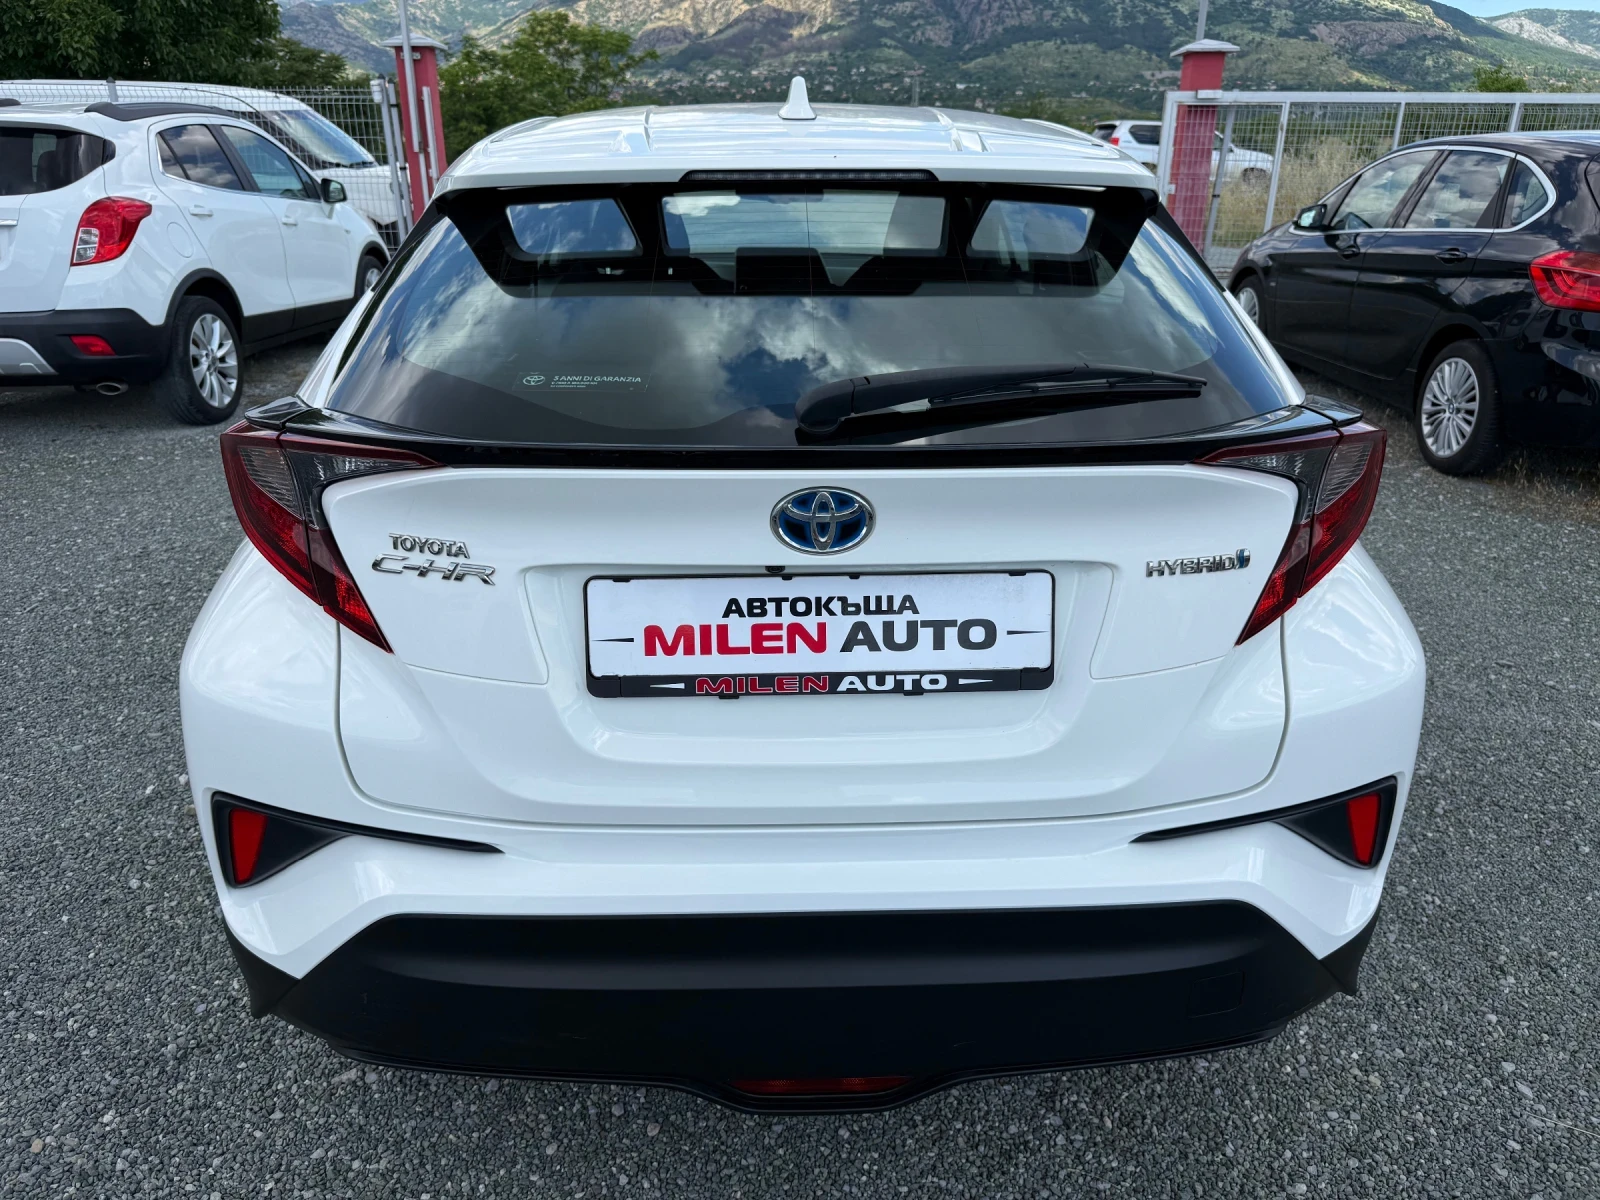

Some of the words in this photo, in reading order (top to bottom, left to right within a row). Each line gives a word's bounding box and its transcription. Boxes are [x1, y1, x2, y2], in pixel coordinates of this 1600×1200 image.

[594, 375, 642, 383] GARANZIA
[389, 533, 470, 559] TOYOTA
[372, 553, 496, 586] C-HR
[1146, 554, 1235, 577] HYBRID
[722, 594, 920, 618] АВТОКЪЩА
[643, 622, 827, 656] MILEN
[840, 618, 998, 653] AUTO
[695, 675, 829, 694] MILEN
[836, 673, 948, 692] AUTO
